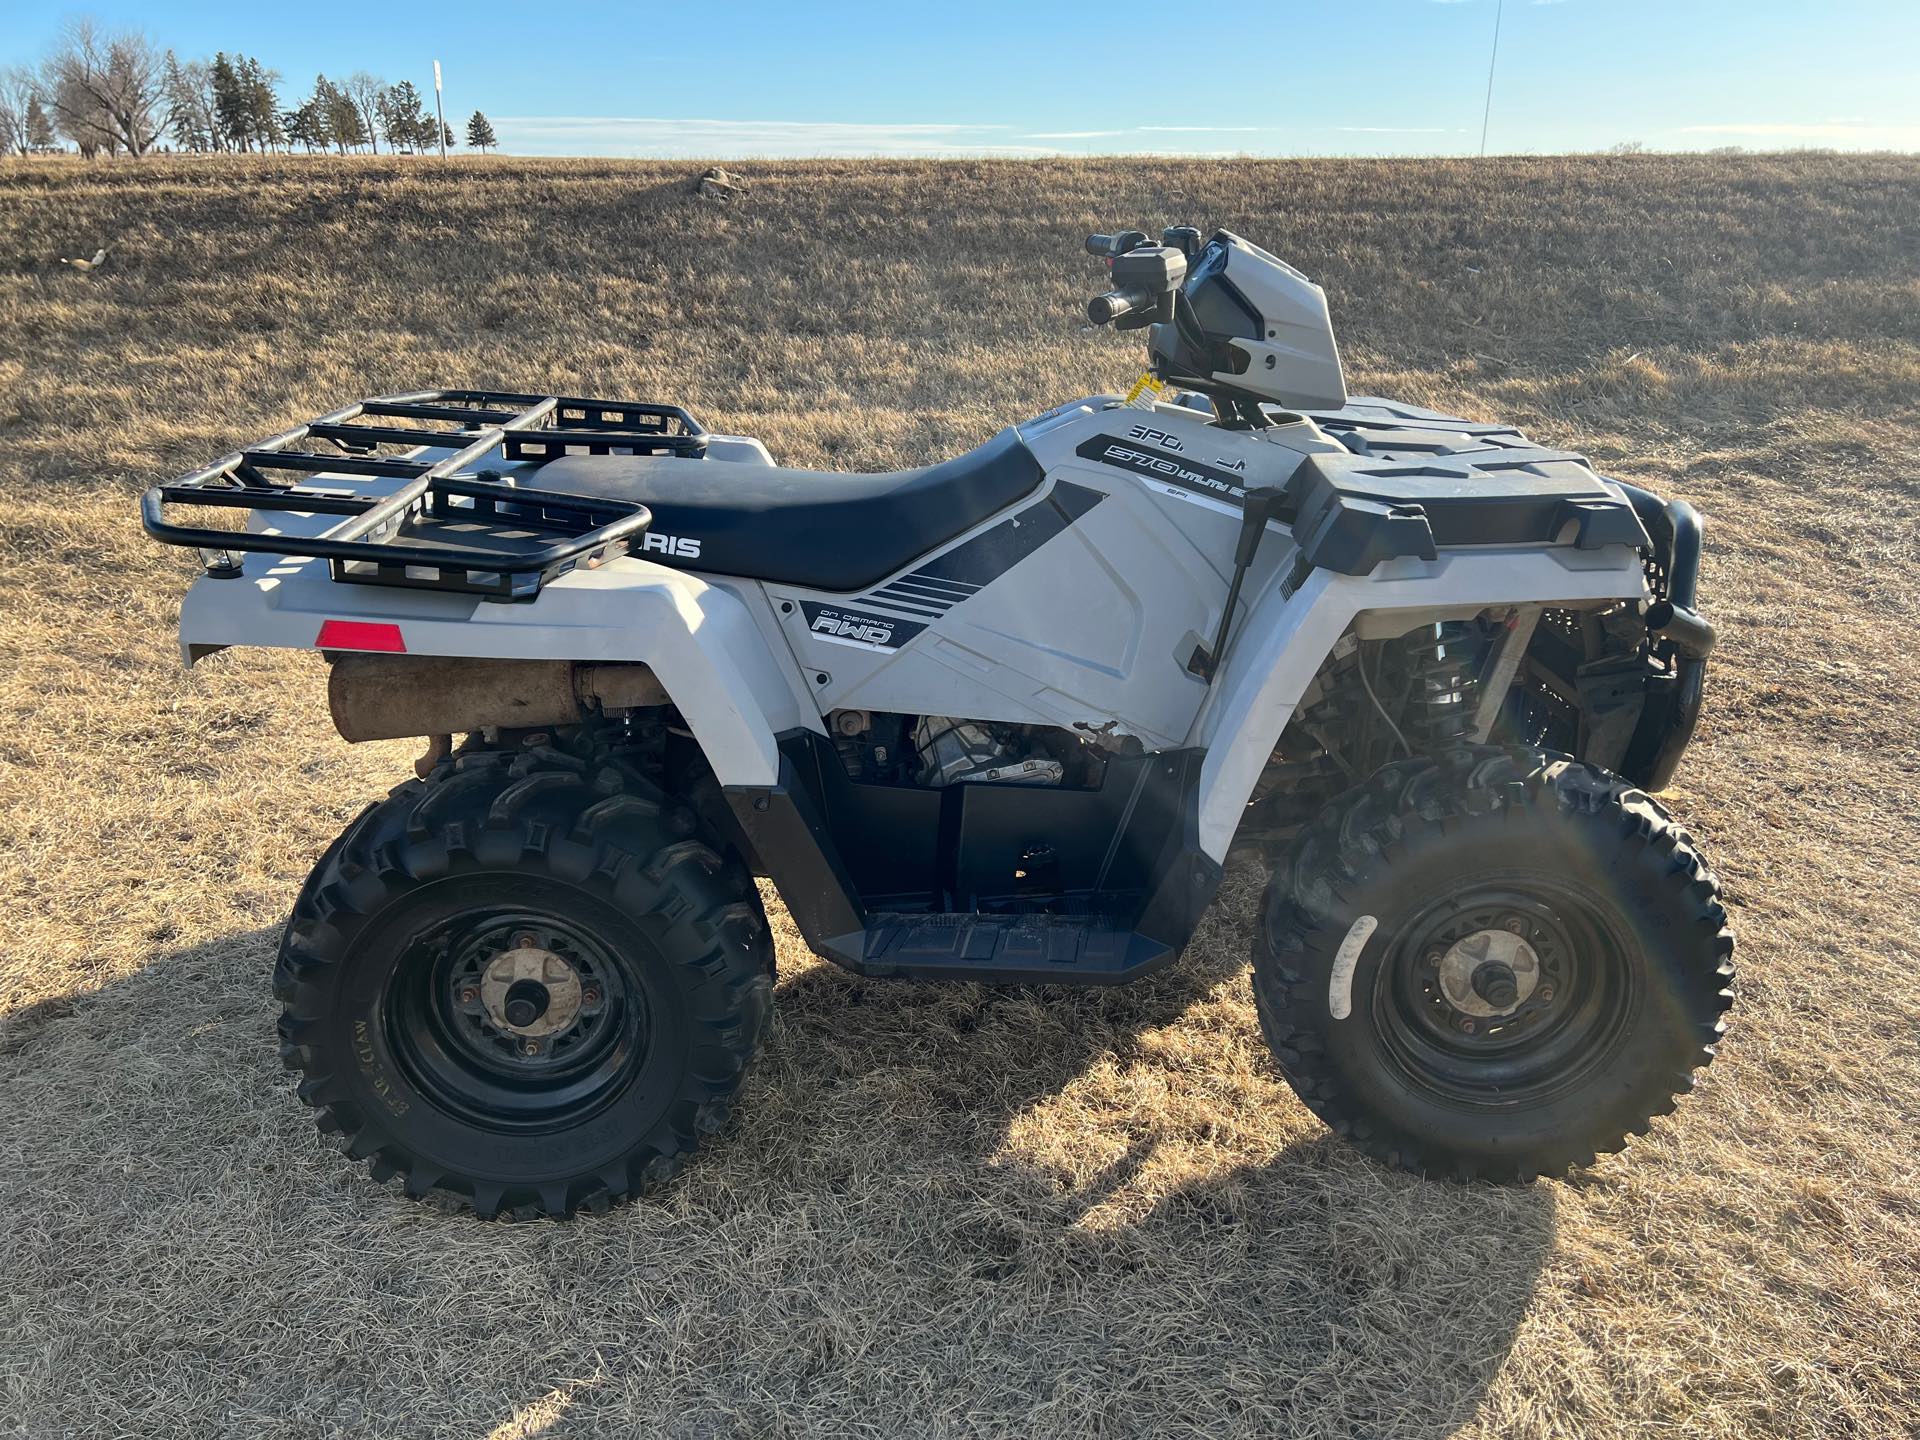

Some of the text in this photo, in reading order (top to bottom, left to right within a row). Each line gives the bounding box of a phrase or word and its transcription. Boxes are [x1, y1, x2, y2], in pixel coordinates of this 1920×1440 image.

[1104, 445, 1180, 475] 570
[1177, 469, 1229, 492] UTILITY
[638, 532, 701, 559] RIS
[811, 616, 892, 644] AWD
[843, 614, 895, 629] DEMAND
